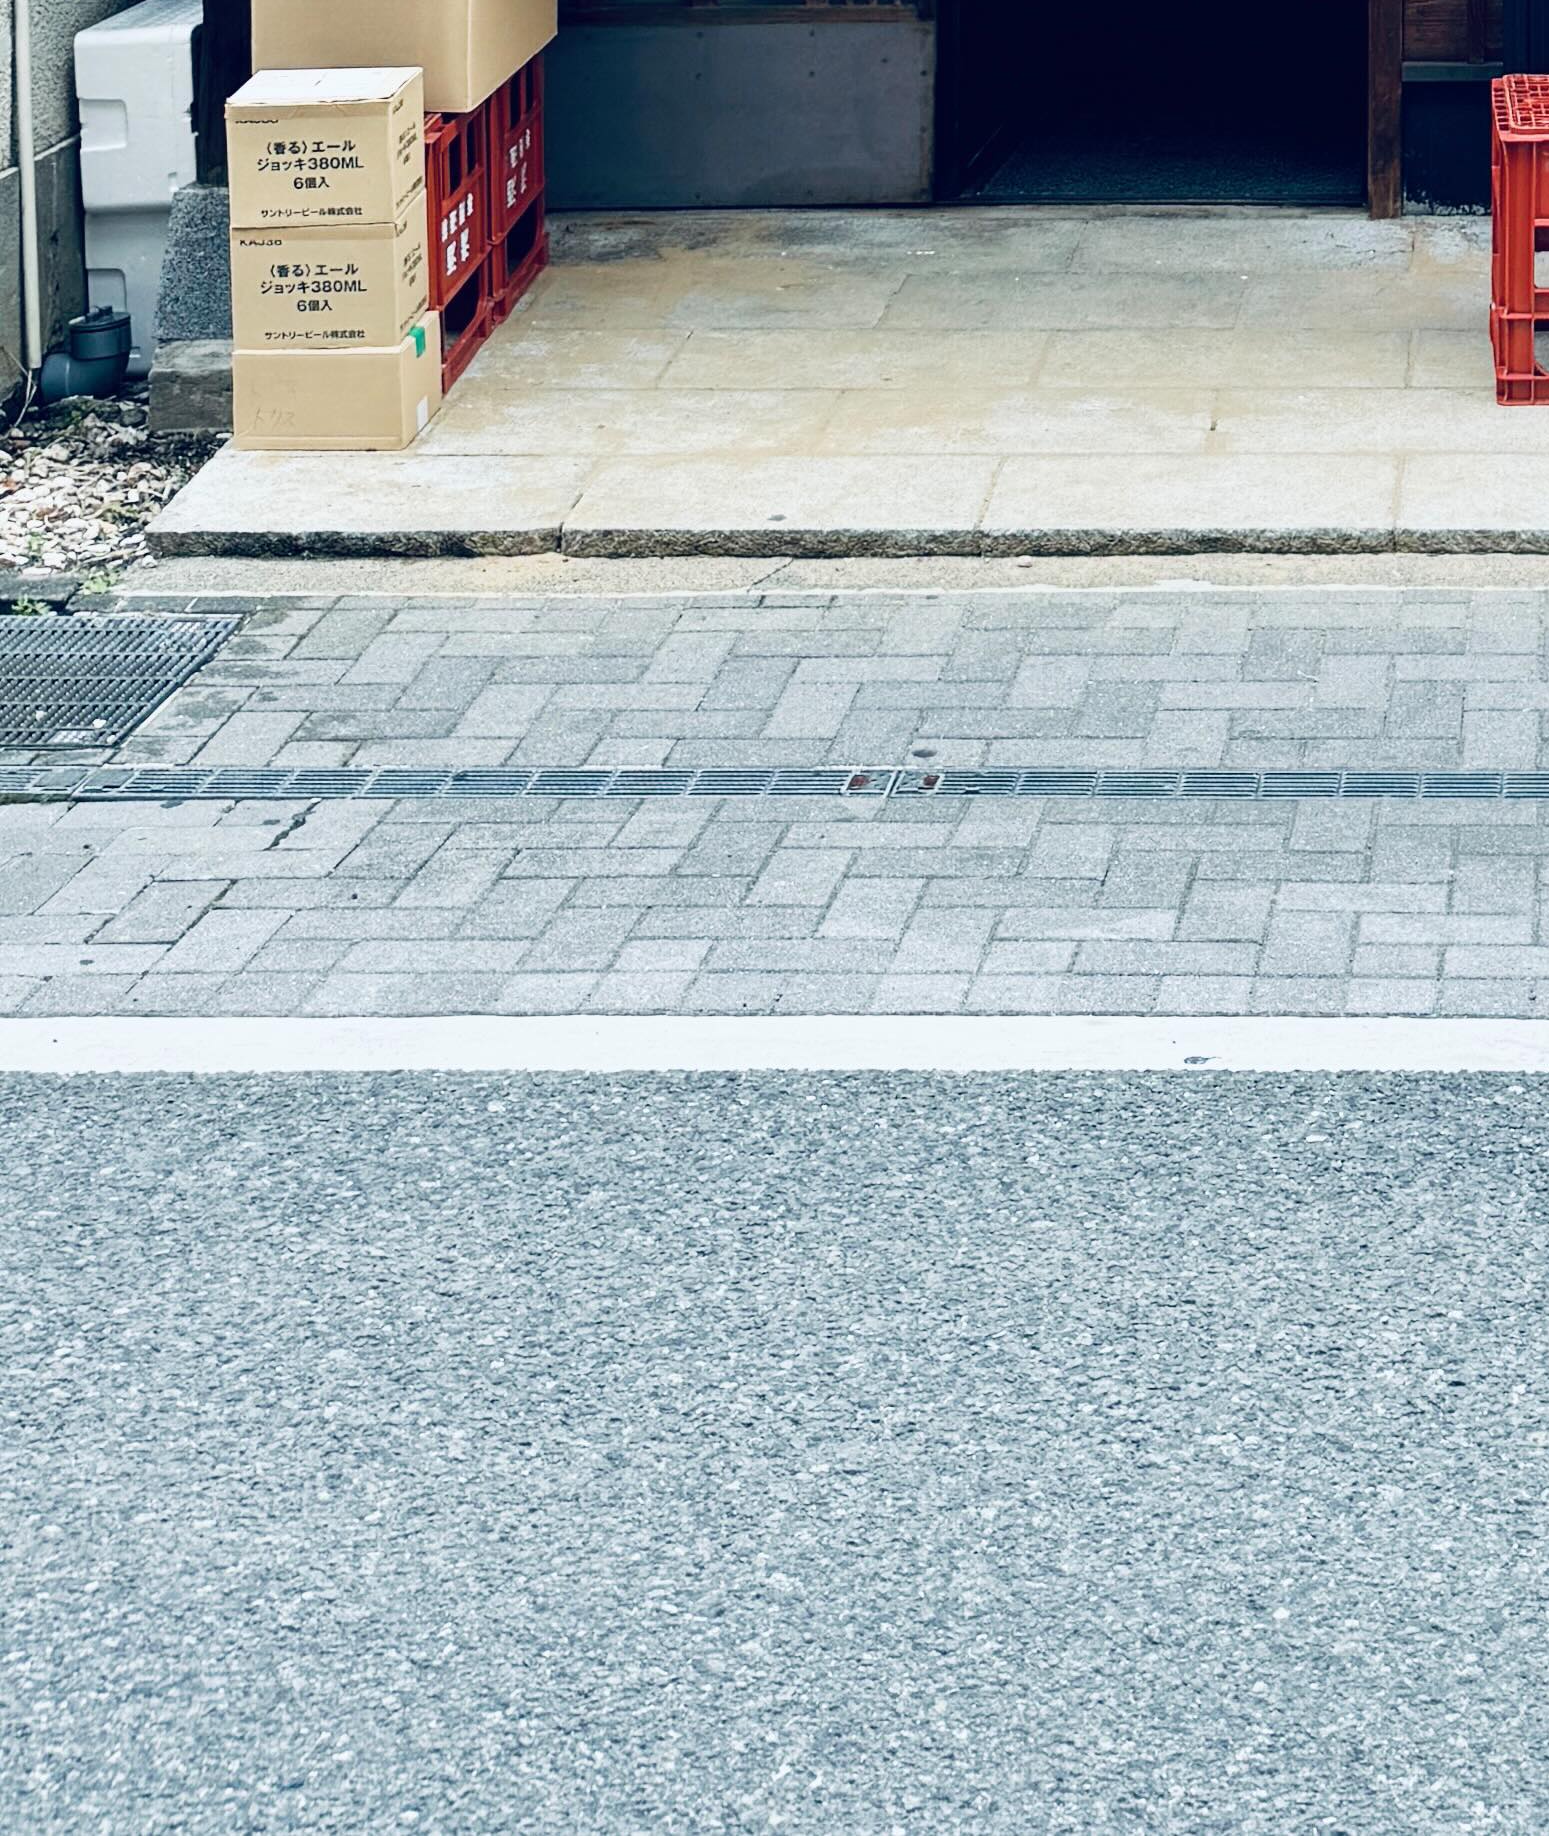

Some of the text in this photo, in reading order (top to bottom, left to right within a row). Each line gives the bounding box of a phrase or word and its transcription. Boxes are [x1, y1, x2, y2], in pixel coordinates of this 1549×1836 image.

[257, 156, 364, 171] ジョッキ380ML
[293, 176, 330, 190] 6個入
[261, 206, 363, 218] サントリービール株式会社
[260, 279, 368, 294] ジョッキ380ML
[296, 299, 333, 312] 6個入
[264, 329, 366, 340] サントリービール株式会社
